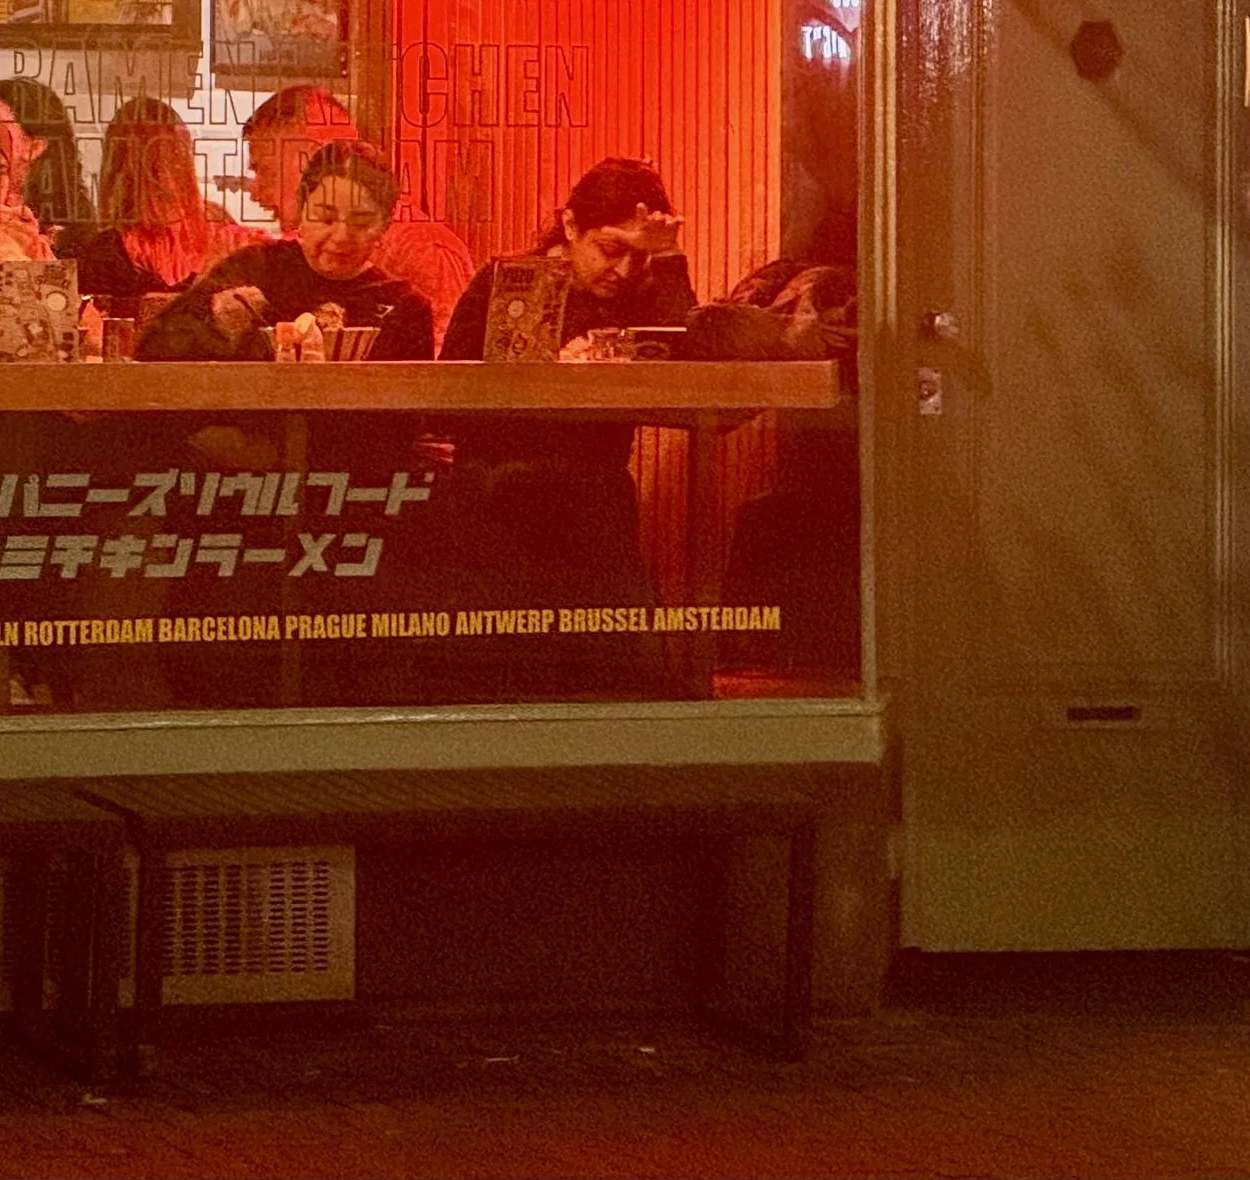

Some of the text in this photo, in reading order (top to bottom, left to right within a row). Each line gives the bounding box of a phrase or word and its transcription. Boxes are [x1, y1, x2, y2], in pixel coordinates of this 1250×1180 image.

[24, 619, 153, 646] ROTTERDAM
[158, 616, 281, 643] BARCELONA
[285, 614, 367, 640] PRAGUE
[371, 612, 450, 638] MILANO
[455, 609, 555, 636] ANTWERP
[559, 607, 649, 633] BRUSSEL
[653, 606, 782, 632] AMSTERDAM
